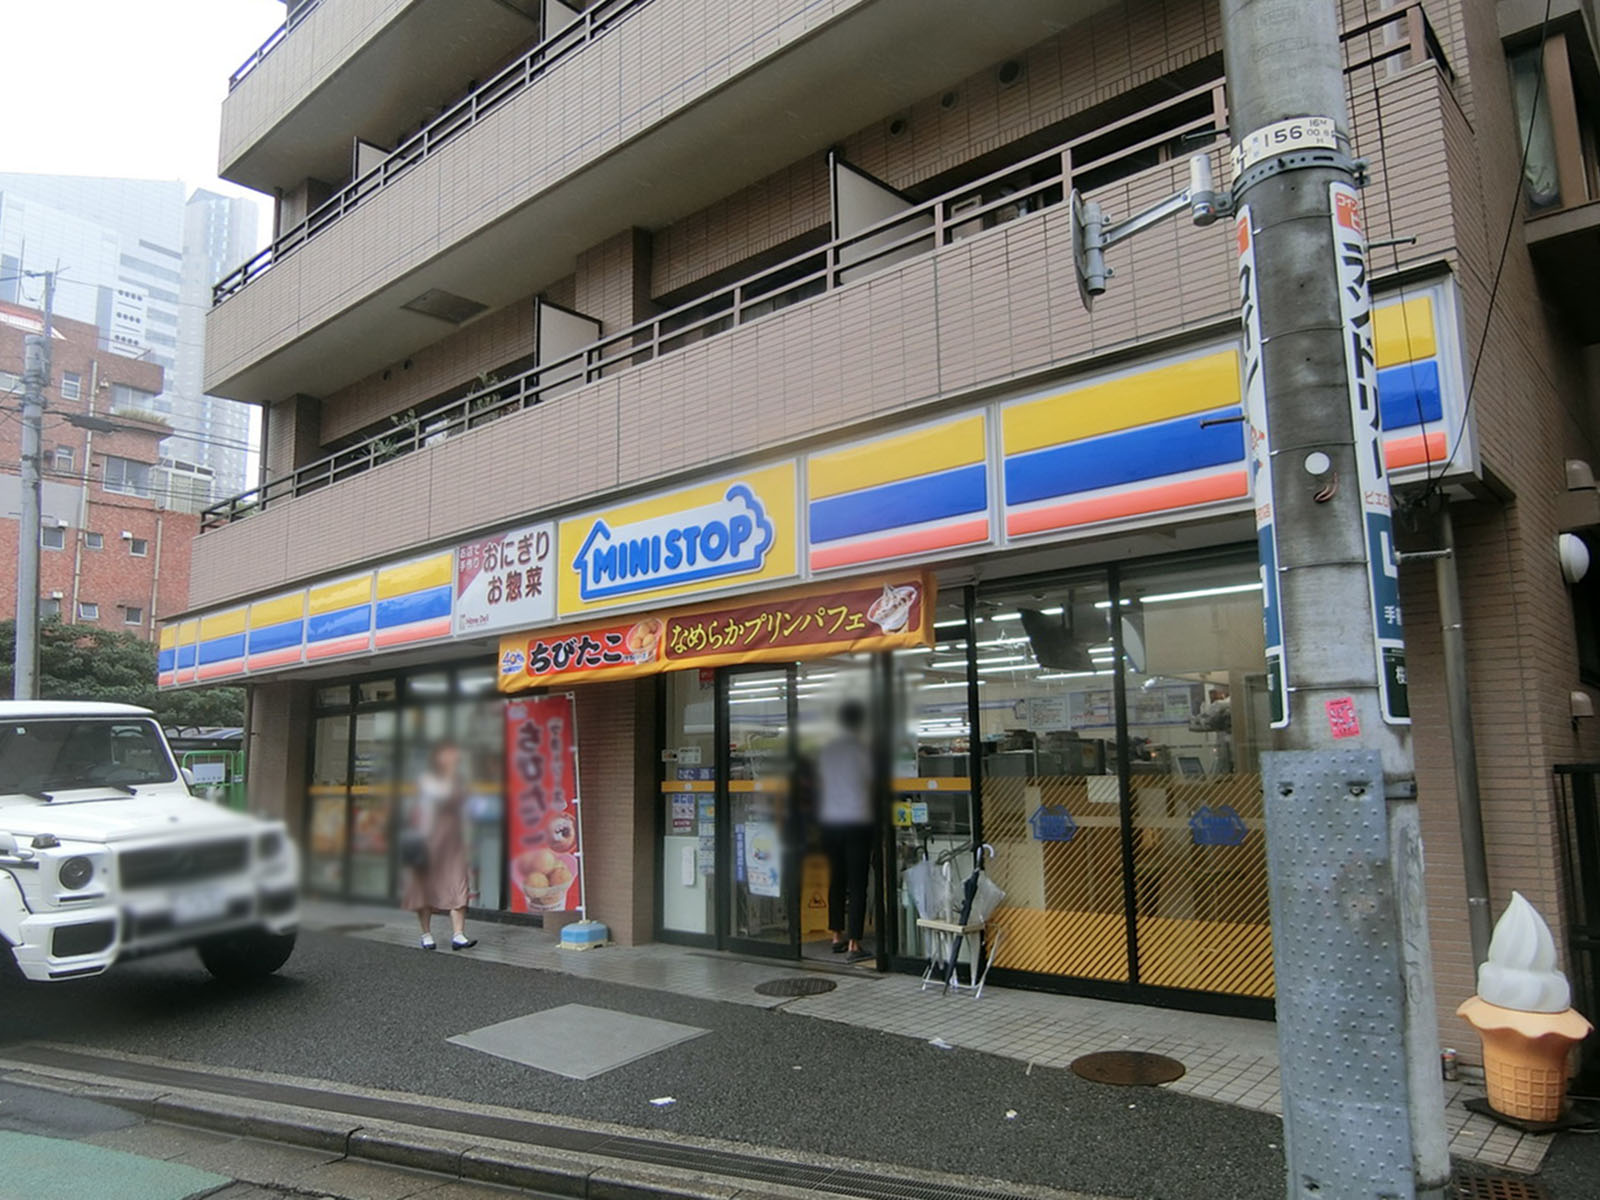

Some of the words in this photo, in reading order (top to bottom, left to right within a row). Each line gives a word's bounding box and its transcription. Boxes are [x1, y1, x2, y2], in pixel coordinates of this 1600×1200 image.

[1264, 126, 1303, 147] 156
[1341, 242, 1382, 480] ランドリー
[483, 531, 550, 573] おにぎり
[592, 514, 753, 584] MINISTOP
[487, 565, 543, 605] お惣菜
[669, 605, 867, 654] なめらかプリンパフェ
[530, 634, 622, 673] ちびたこ
